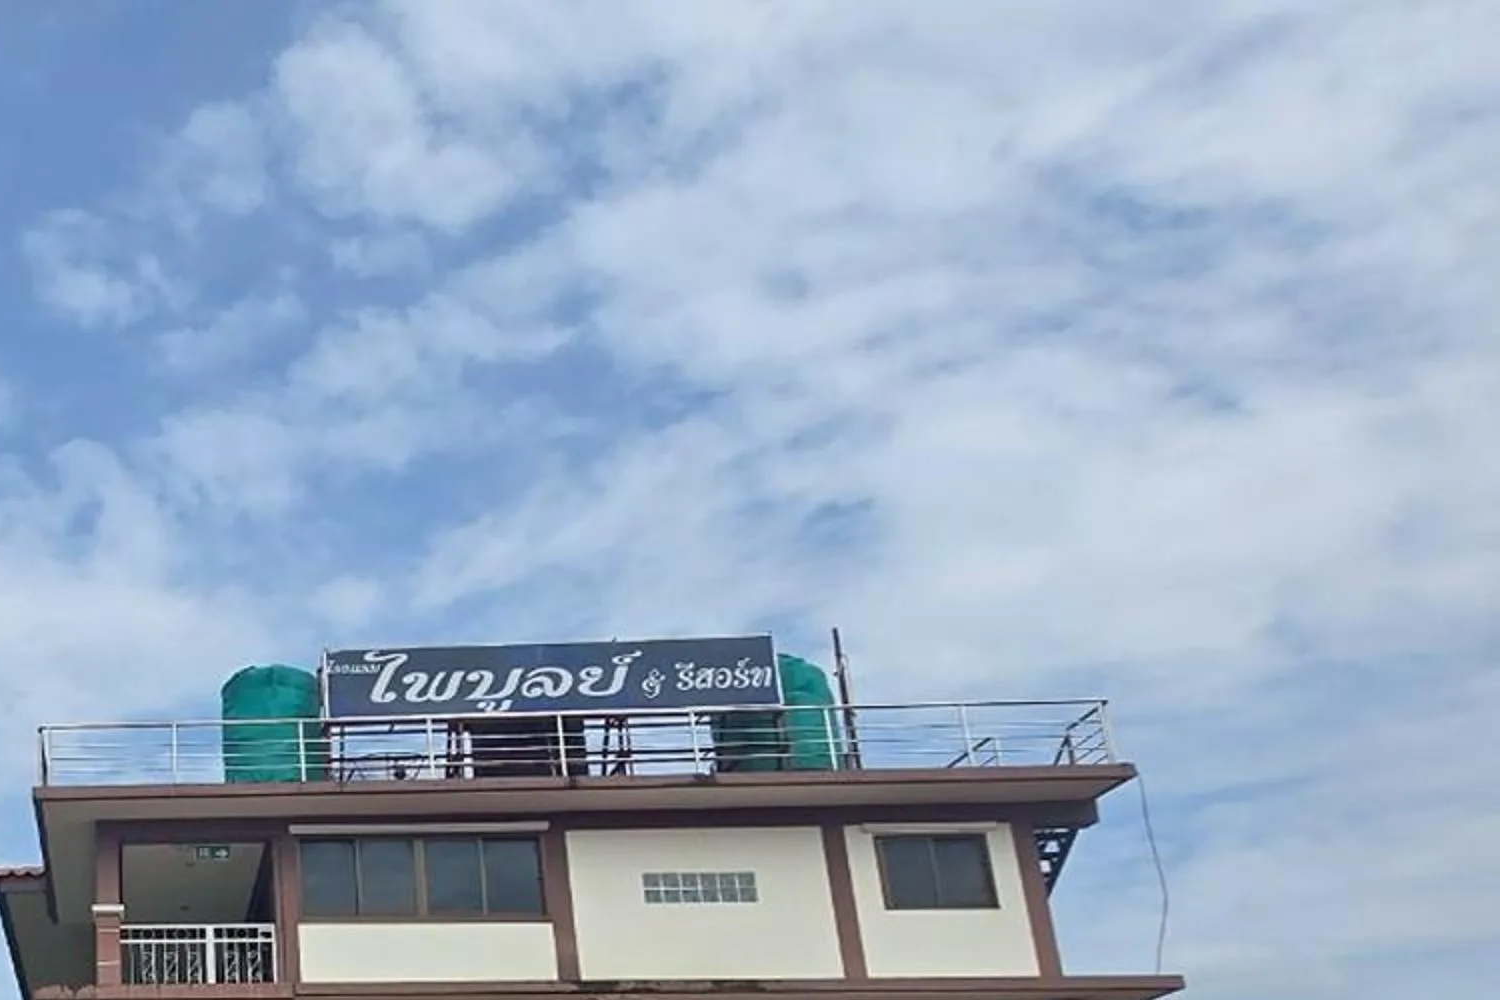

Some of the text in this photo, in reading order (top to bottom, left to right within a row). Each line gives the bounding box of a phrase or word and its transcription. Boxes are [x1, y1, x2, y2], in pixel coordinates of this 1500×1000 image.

[363, 651, 642, 711] ไพบูลย์
[674, 659, 772, 692] รีสอร์ท
